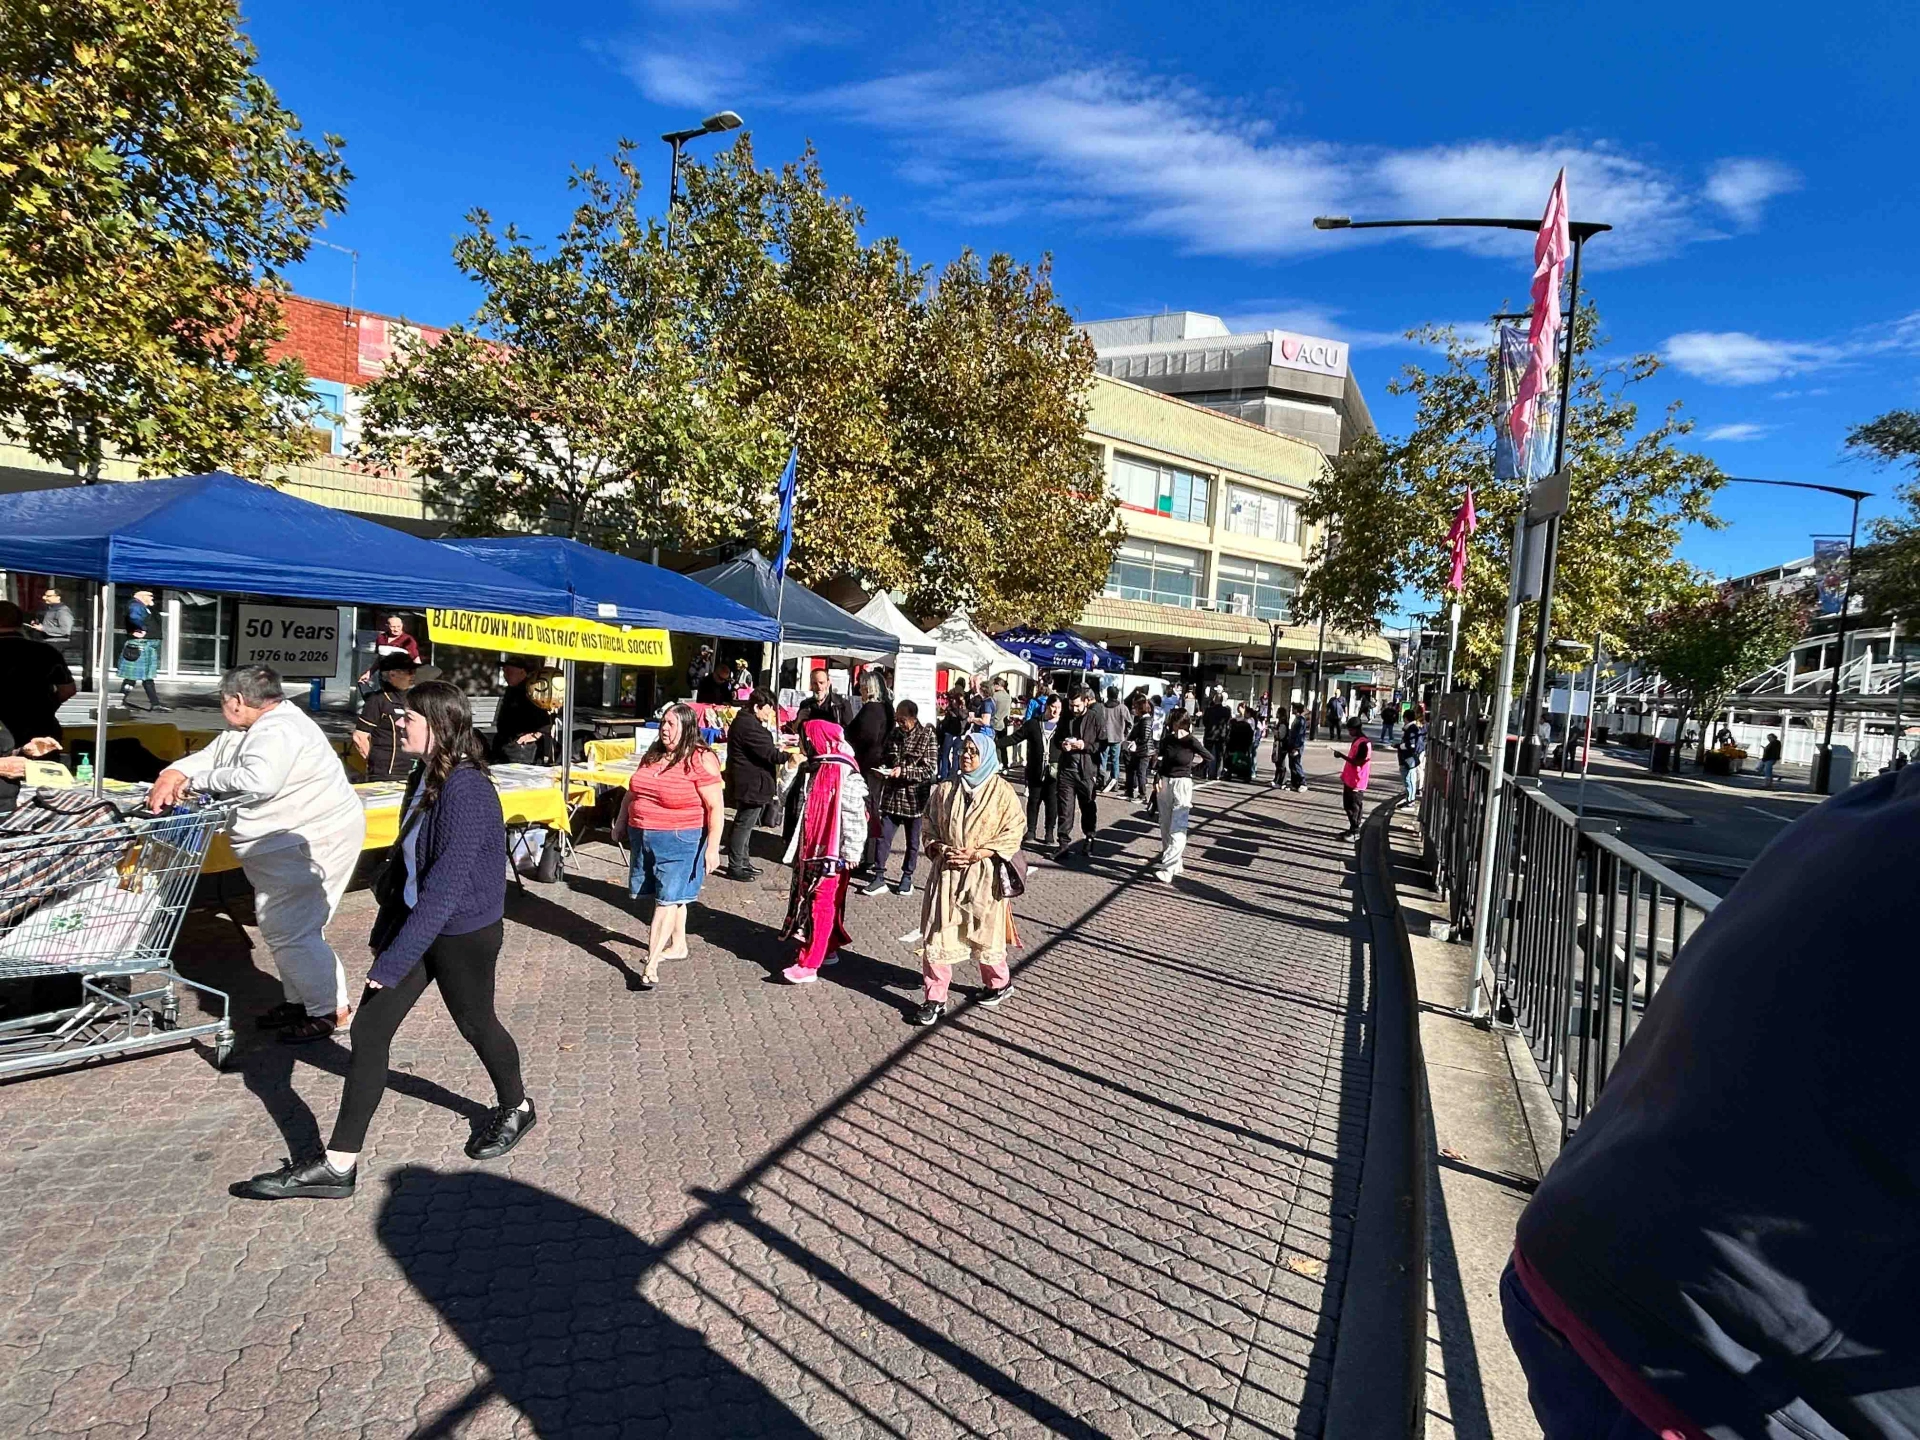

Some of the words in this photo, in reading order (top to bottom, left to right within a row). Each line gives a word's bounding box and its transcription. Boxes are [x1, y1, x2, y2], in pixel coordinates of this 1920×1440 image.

[1296, 343, 1340, 368] ACU
[245, 618, 273, 638] 50
[280, 620, 336, 640] Years
[432, 609, 508, 638] BLACKTOWN
[511, 621, 534, 641] AND
[536, 625, 580, 648] DISTRICT
[627, 639, 664, 656] SOCIETY
[249, 649, 281, 662] 1976
[284, 651, 297, 662] to
[299, 650, 329, 662] 2026
[1053, 656, 1084, 667] WATER
